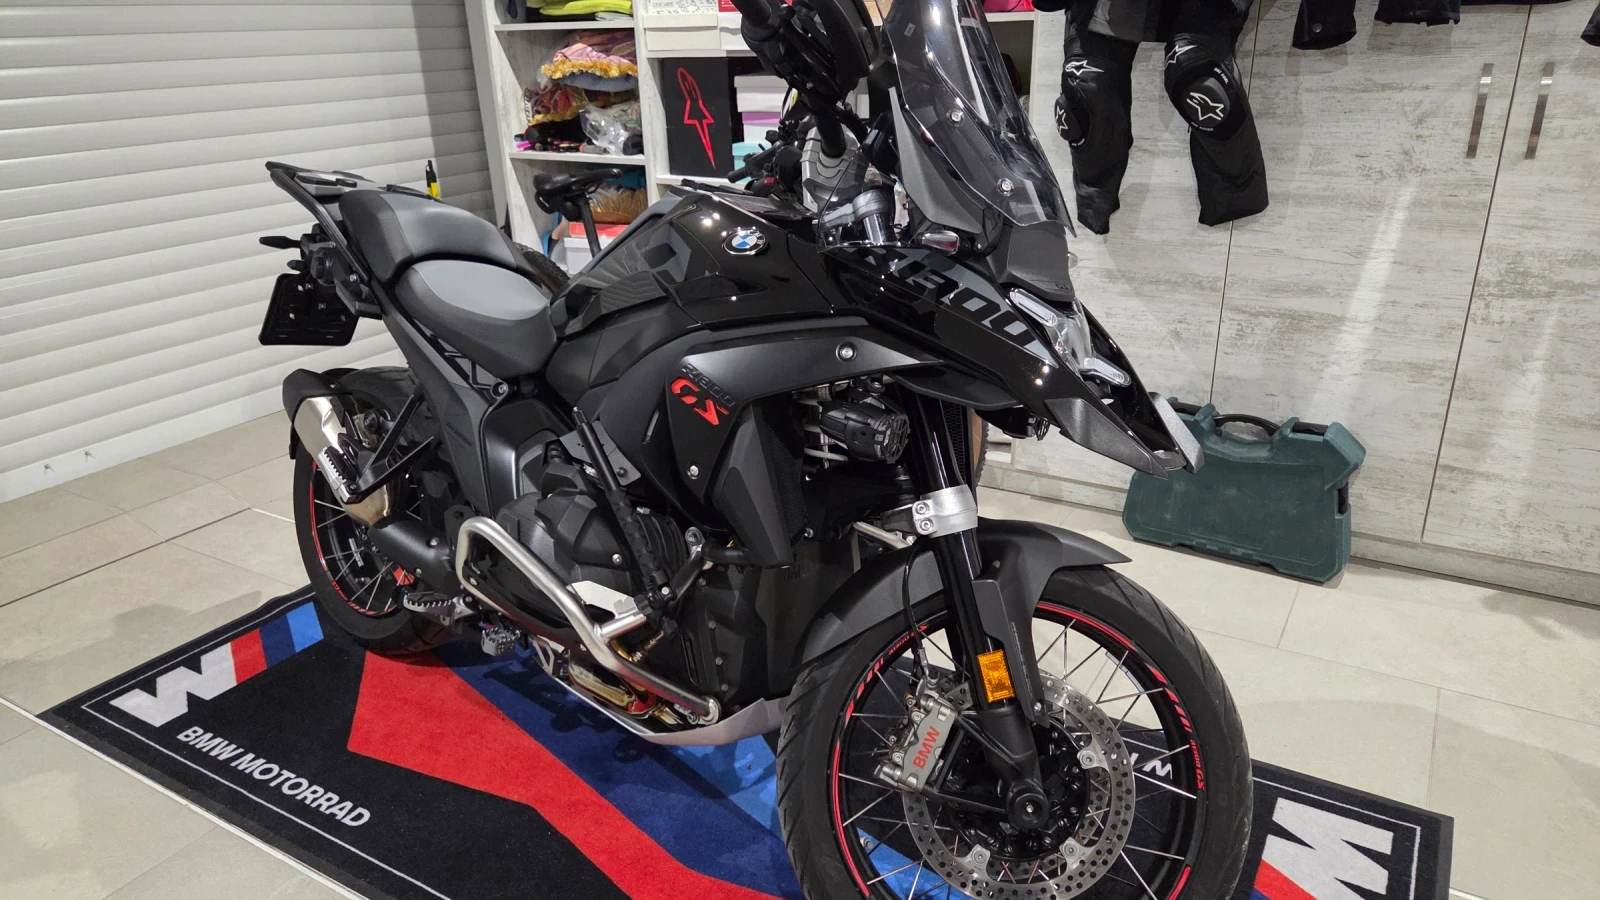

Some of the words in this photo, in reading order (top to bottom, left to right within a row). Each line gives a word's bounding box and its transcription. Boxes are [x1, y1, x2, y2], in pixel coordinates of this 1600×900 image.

[671, 377, 729, 425] GS
[913, 725, 940, 769] BMW
[176, 726, 244, 761] BMW
[230, 752, 371, 826] MOTORRAD
